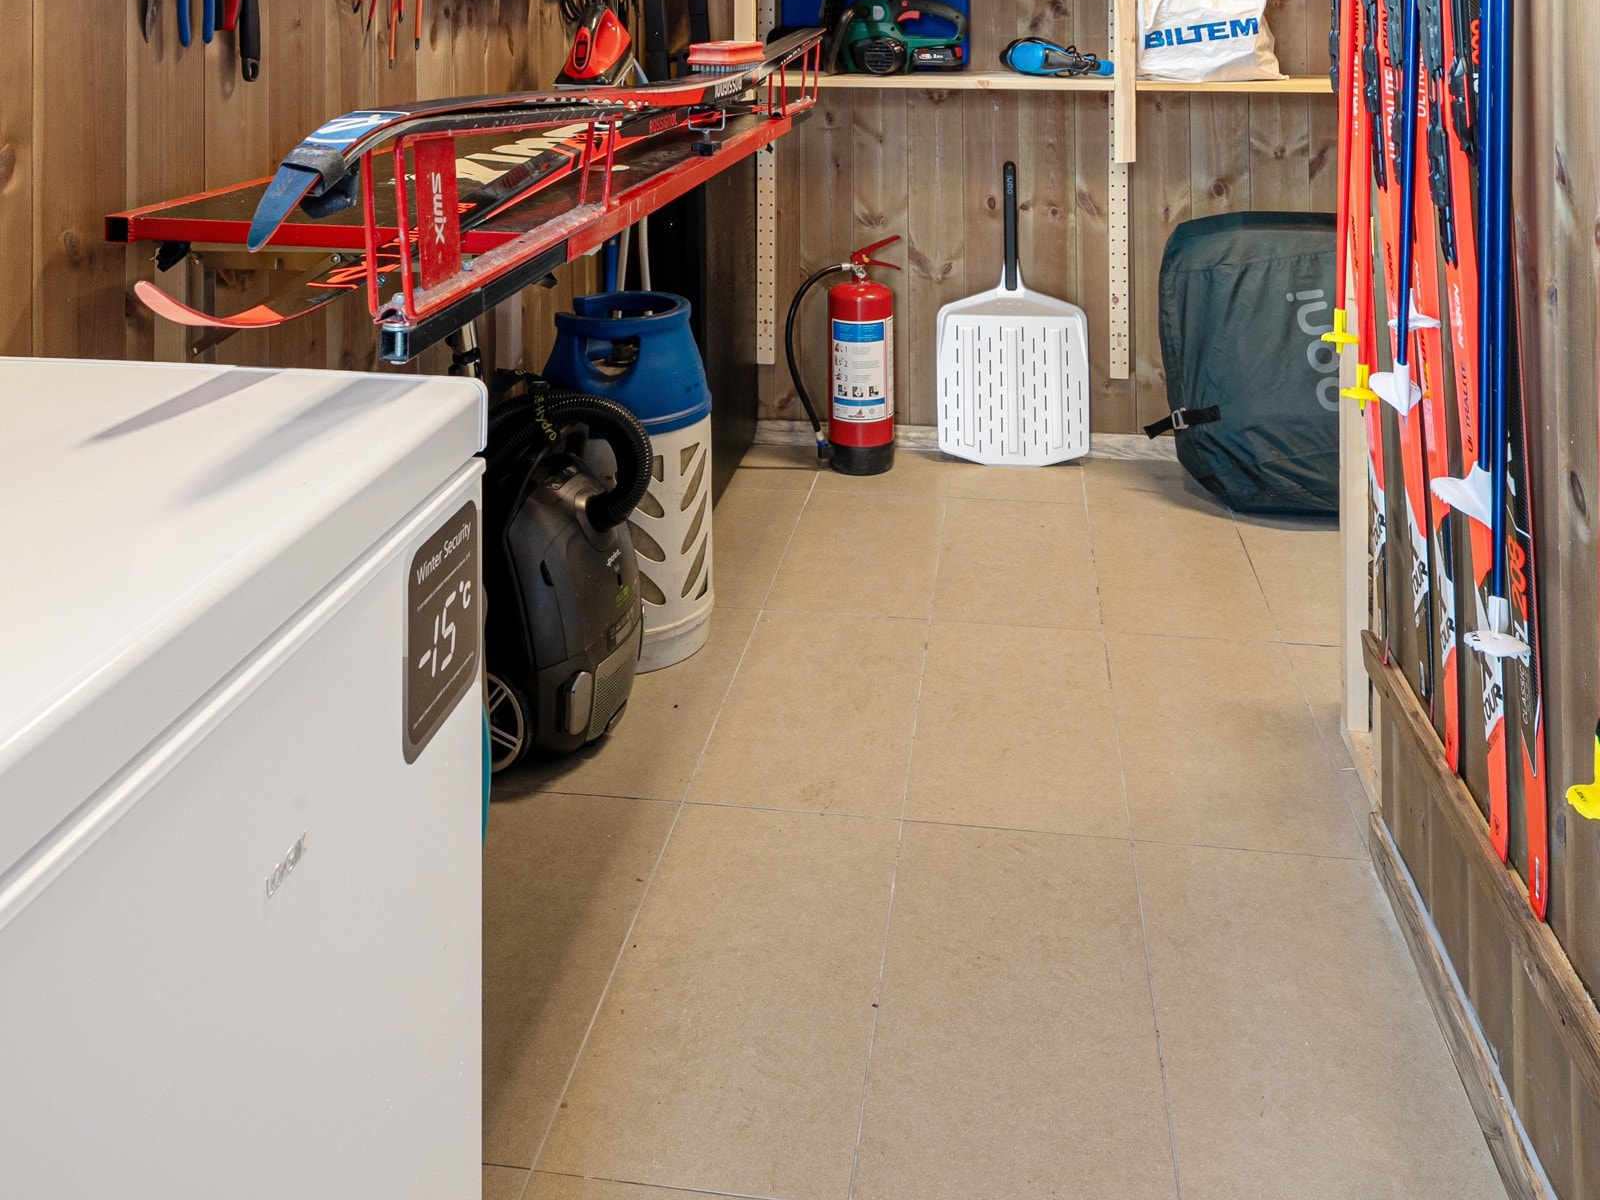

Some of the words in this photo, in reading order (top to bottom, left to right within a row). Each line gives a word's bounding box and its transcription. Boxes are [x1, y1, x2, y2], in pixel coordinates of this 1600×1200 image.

[1144, 17, 1259, 50] BILTEM
[416, 548, 443, 586] Winter
[443, 520, 472, 559] Security
[1507, 534, 1529, 622] 208
